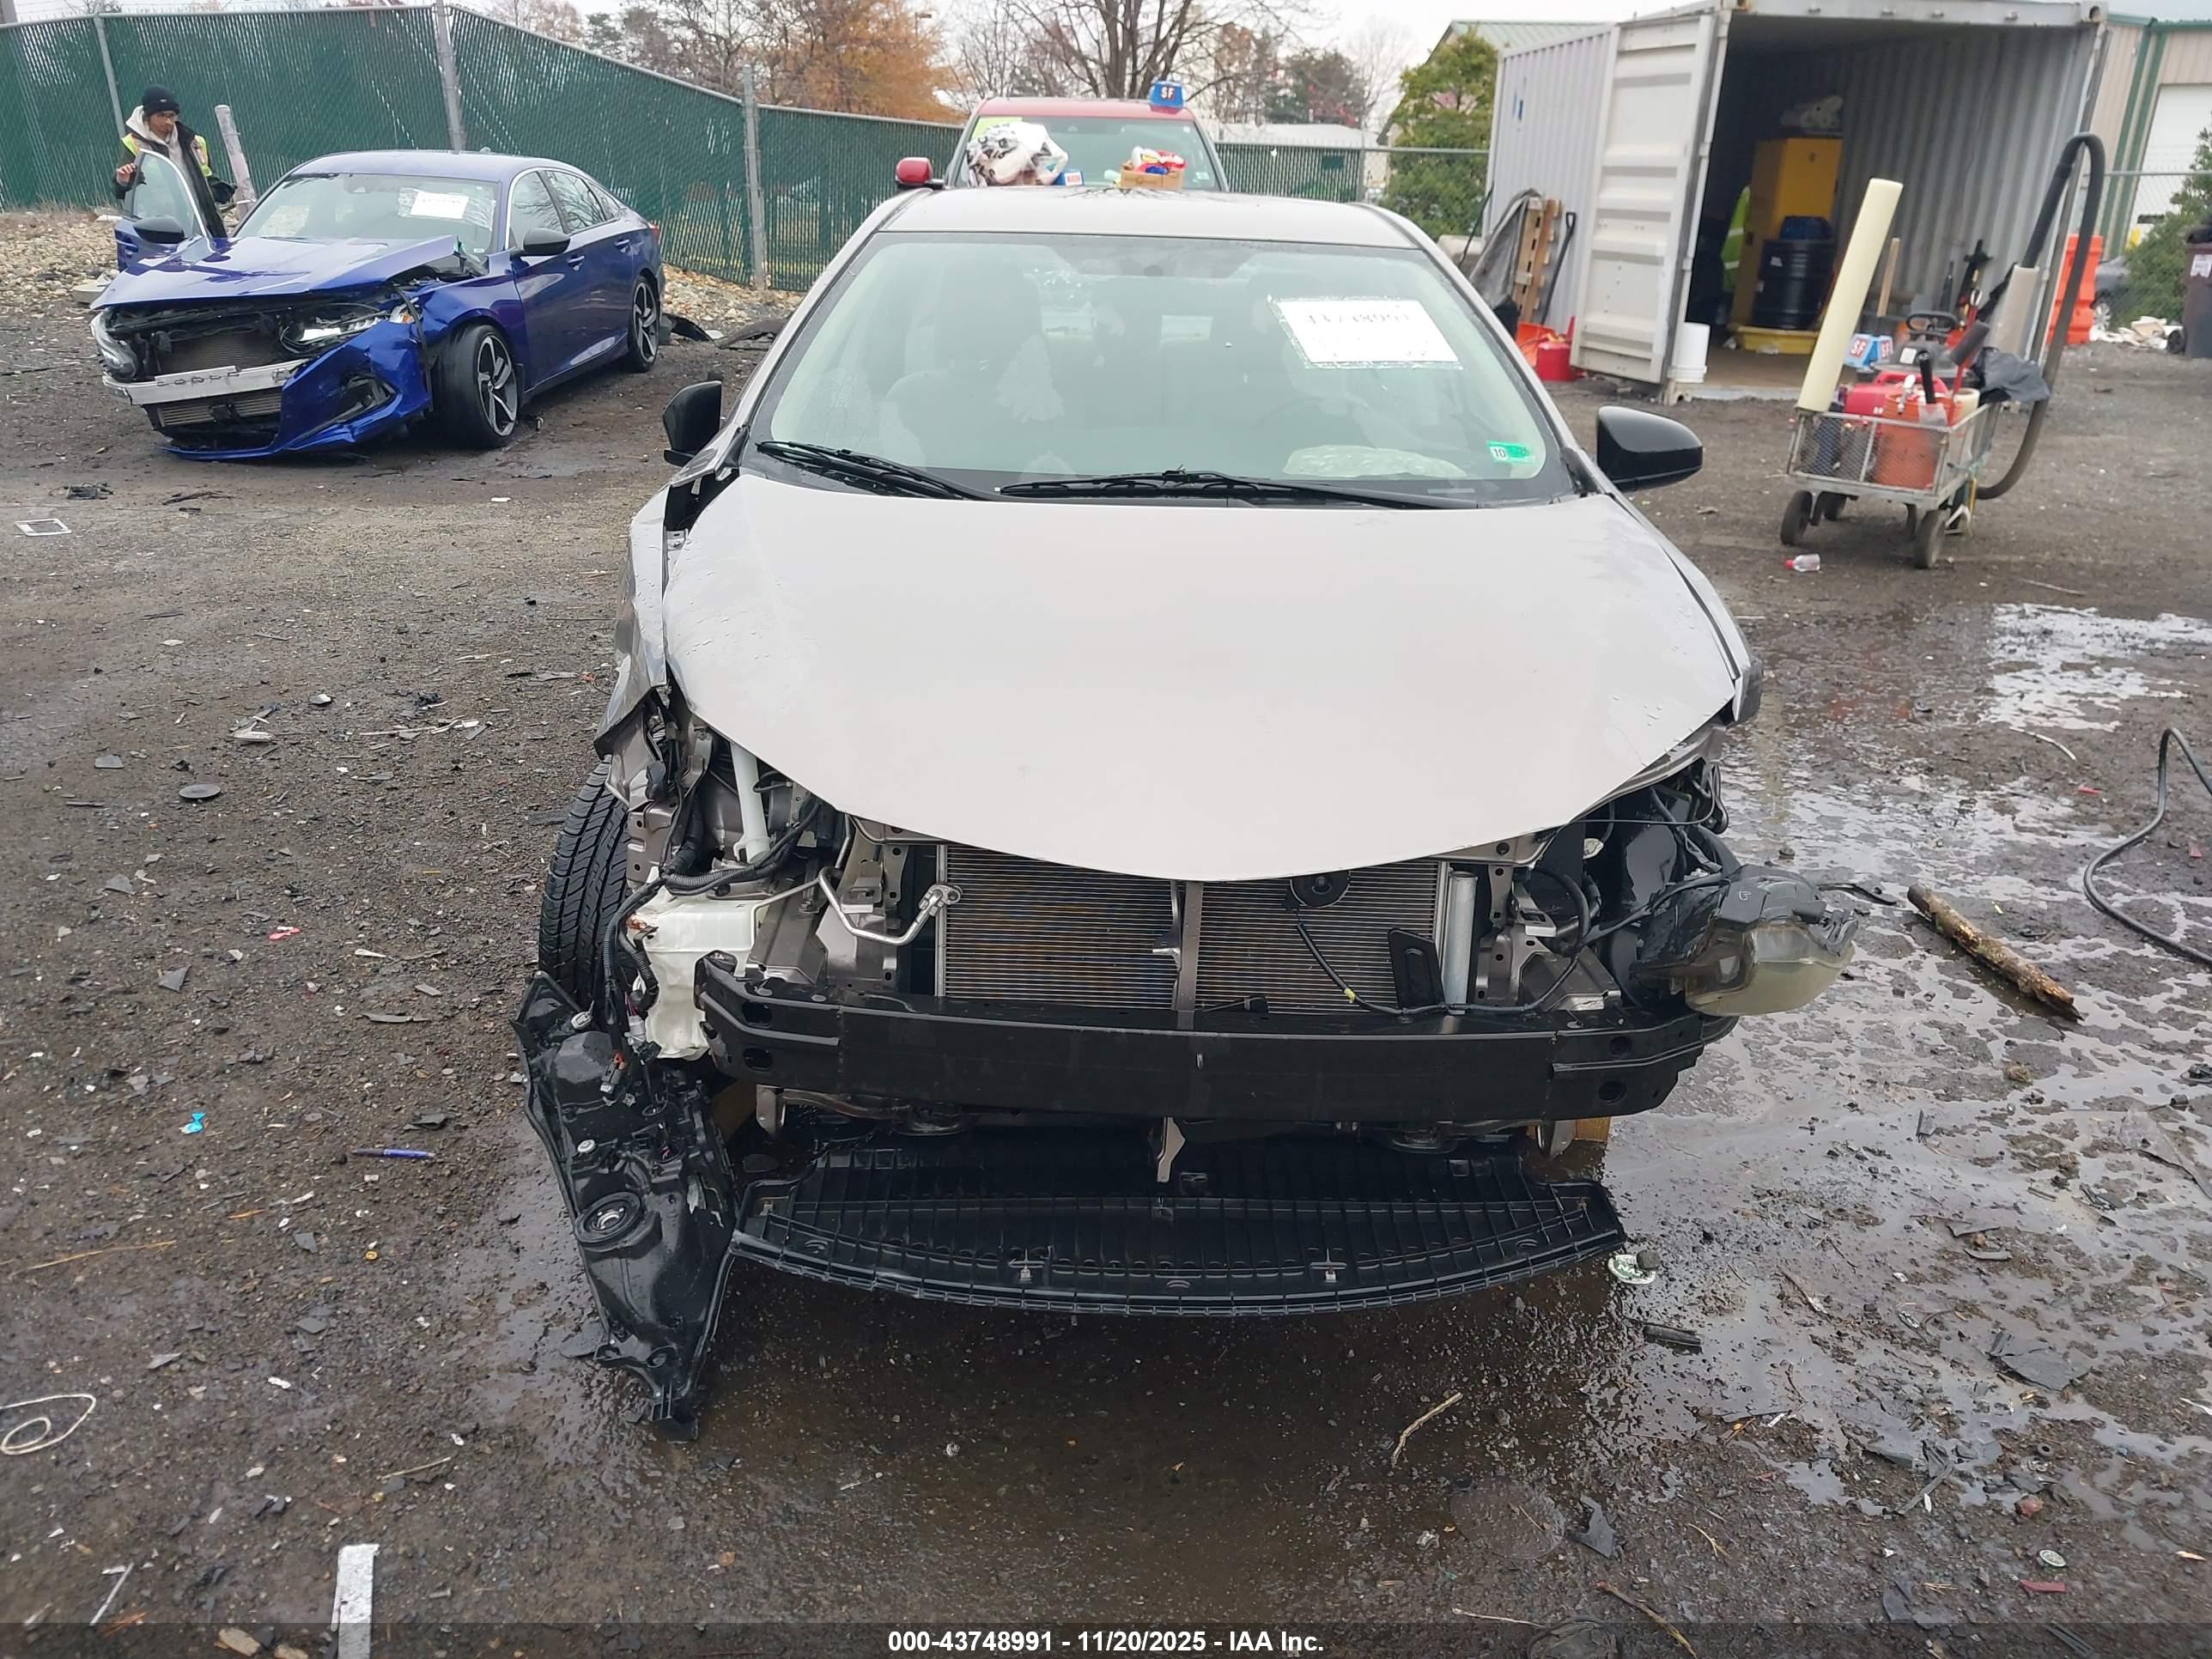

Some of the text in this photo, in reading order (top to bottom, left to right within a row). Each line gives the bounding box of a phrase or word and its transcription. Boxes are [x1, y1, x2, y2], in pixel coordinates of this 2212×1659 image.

[1161, 86, 1175, 100] SF
[1851, 339, 1866, 356] SF
[1493, 448, 1506, 458] 10
